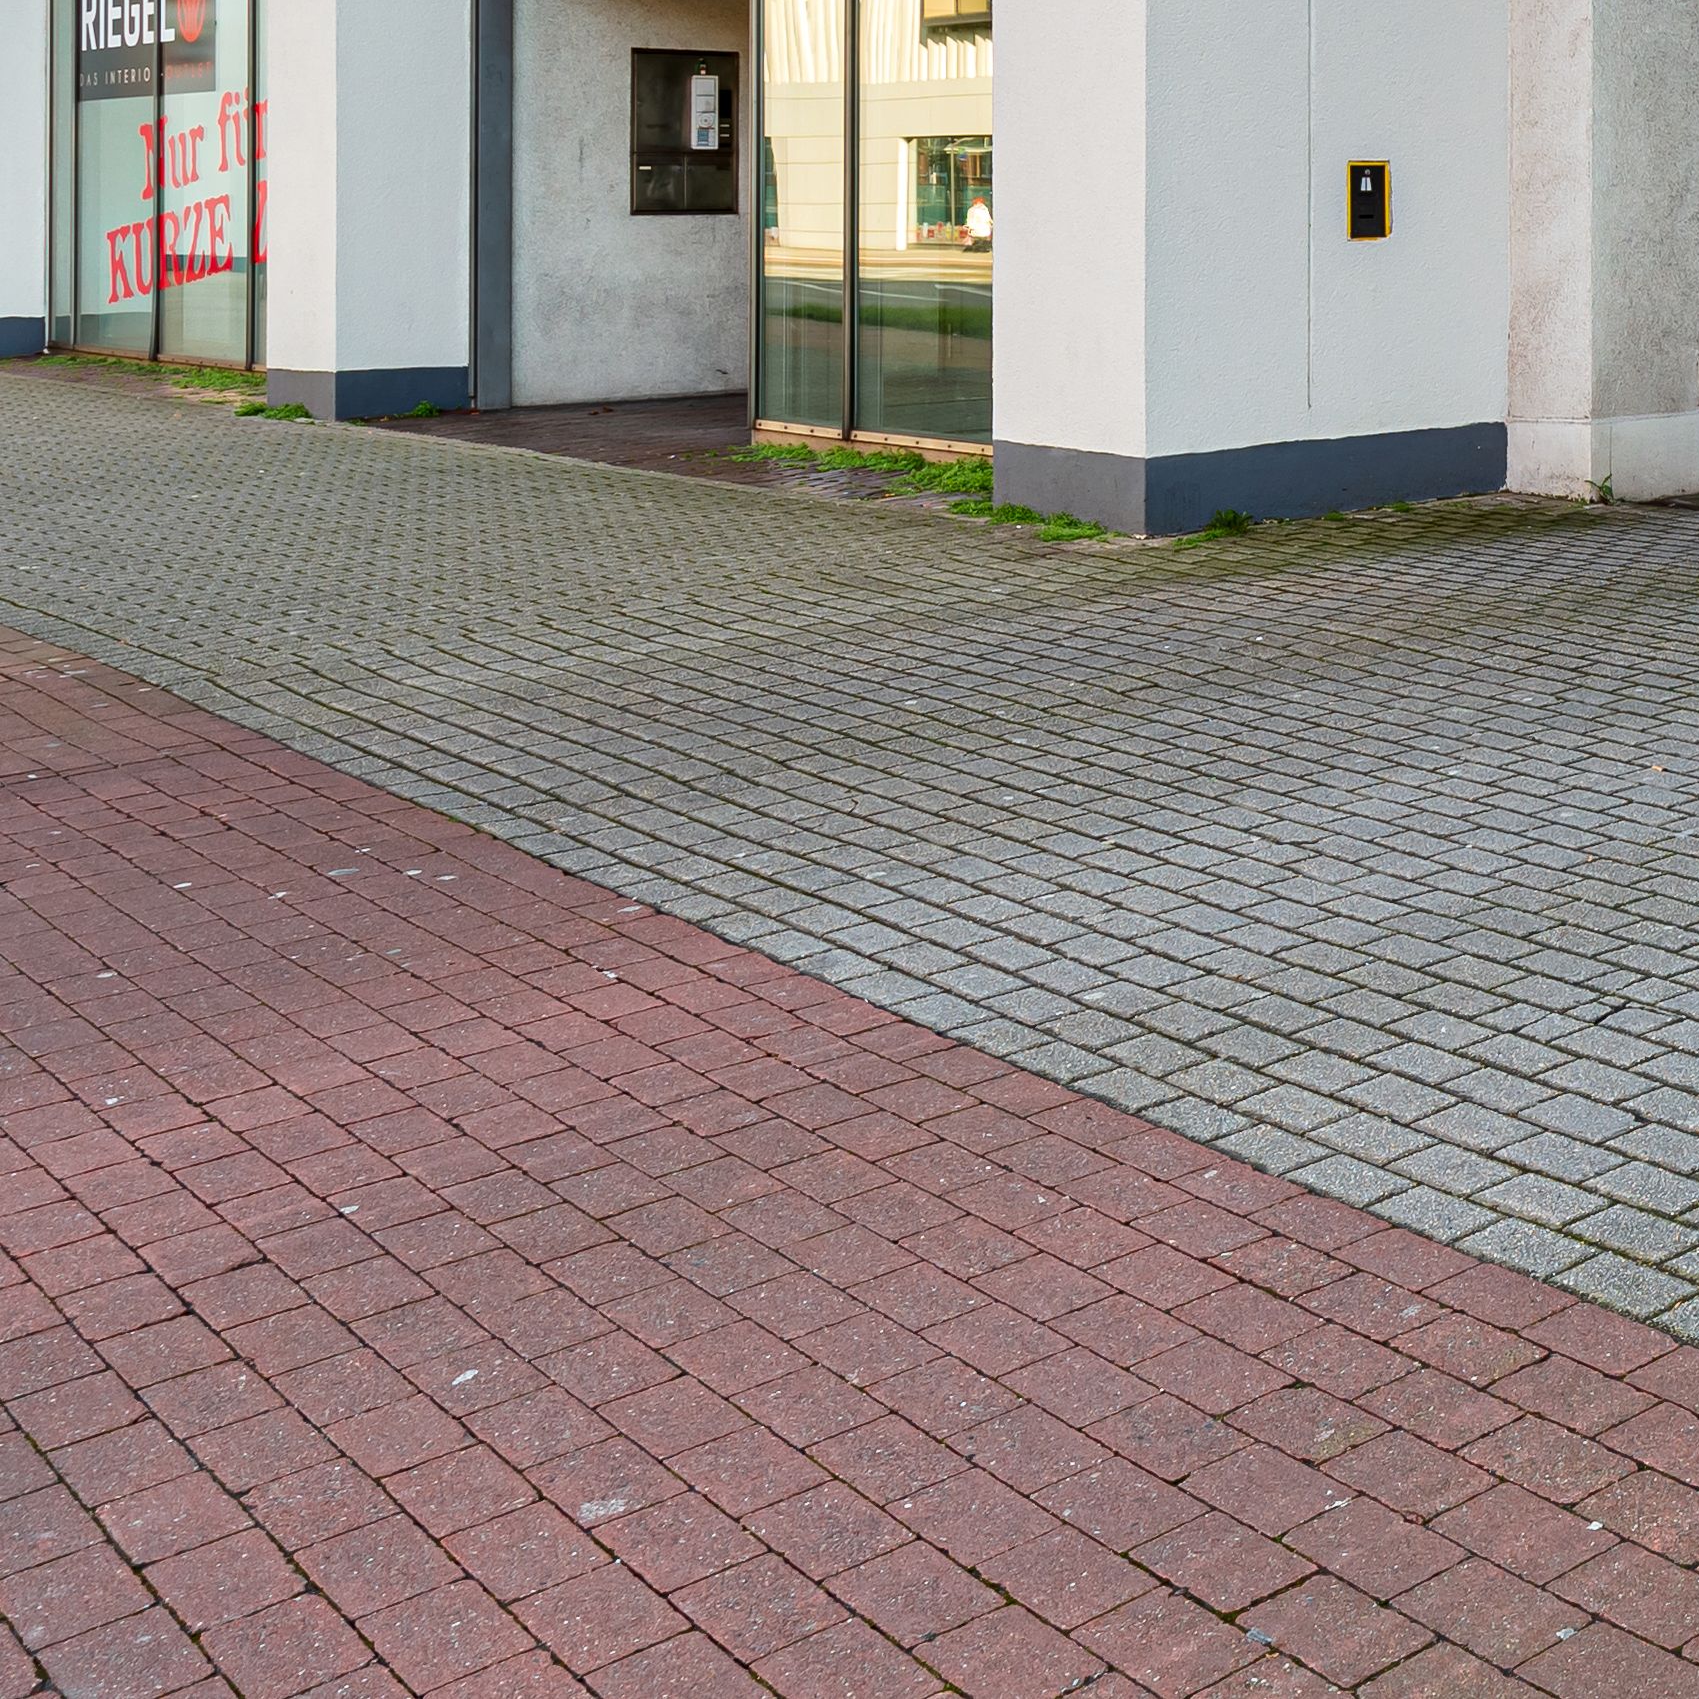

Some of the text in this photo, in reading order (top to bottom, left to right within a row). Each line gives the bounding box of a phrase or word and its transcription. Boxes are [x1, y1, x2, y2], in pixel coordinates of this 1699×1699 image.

[79, 72, 99, 87] DAS
[138, 115, 205, 200] Nur
[106, 193, 234, 304] KURZE
